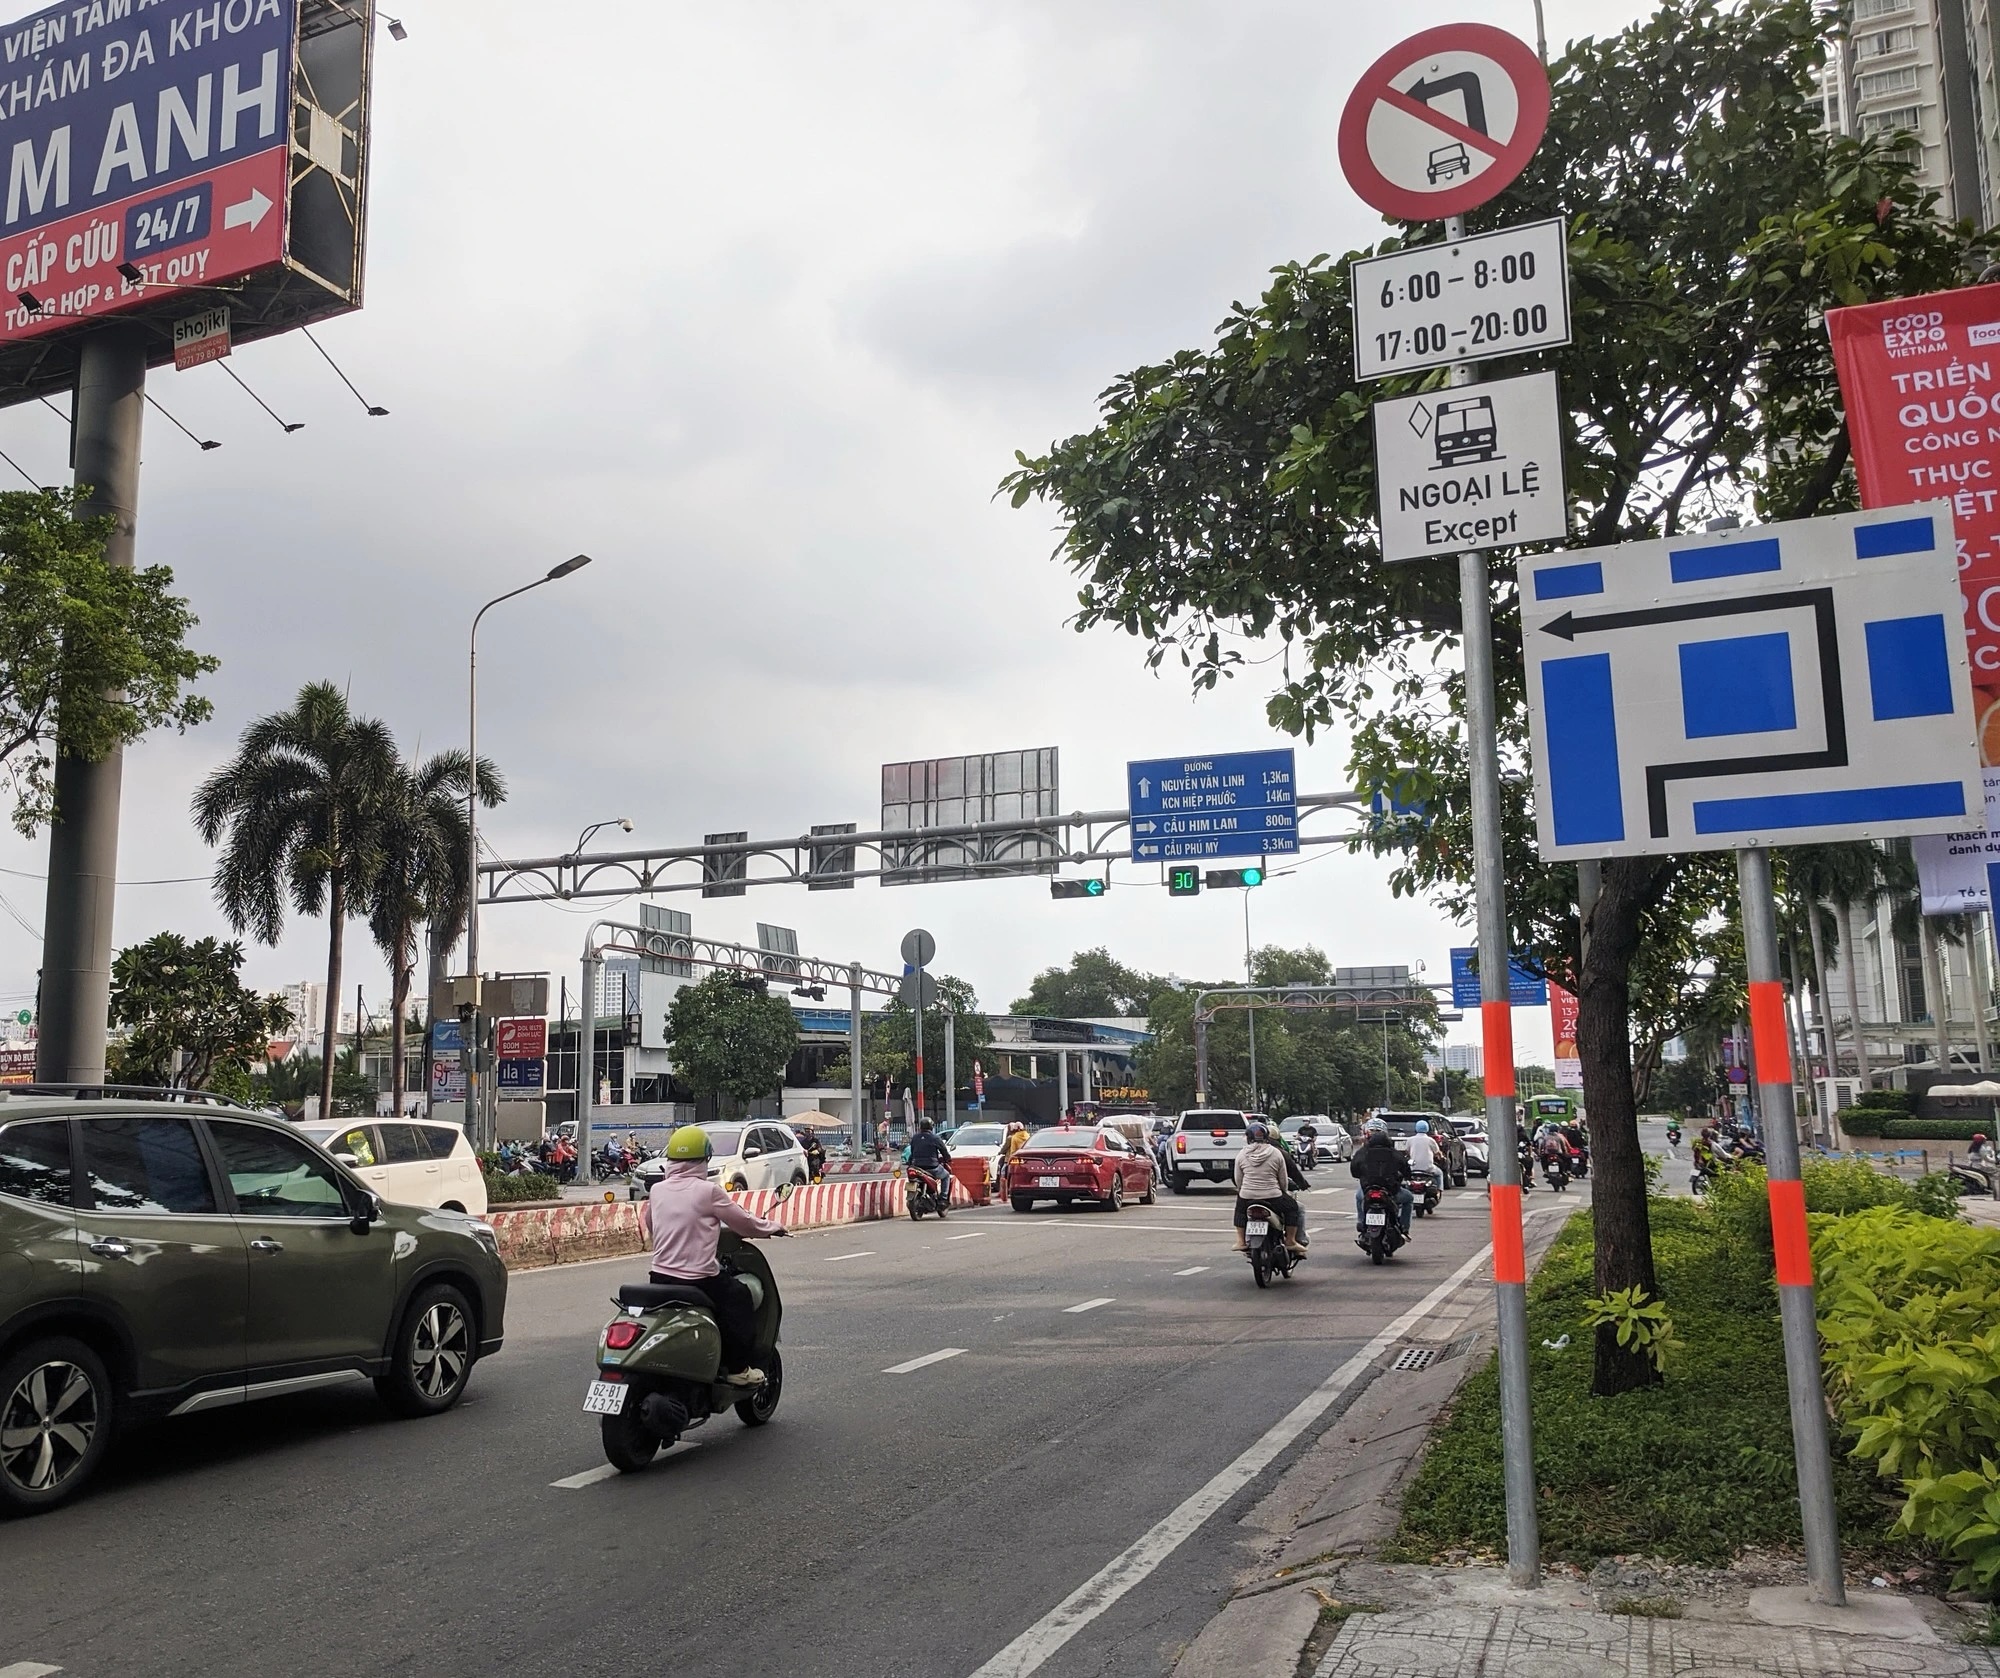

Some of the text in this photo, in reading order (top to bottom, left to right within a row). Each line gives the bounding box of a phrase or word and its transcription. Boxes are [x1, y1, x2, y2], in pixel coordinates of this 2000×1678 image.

[5, 14, 66, 63] VIỆN
[101, 29, 155, 82] ĐA
[169, 0, 281, 57] KHOA
[92, 48, 279, 196] ANH
[6, 195, 201, 293] CẤP CỨU 24/7
[61, 283, 100, 315] HỢP
[104, 286, 115, 301] &
[166, 248, 210, 283] QUỴ
[1380, 270, 1441, 308] 6:00
[1474, 250, 1535, 289] 8:00
[176, 309, 225, 341] shojiki
[1882, 311, 1943, 334] FOOD
[1884, 326, 1946, 348] EXPO
[195, 352, 205, 362] 79
[217, 345, 227, 355] 79
[1888, 341, 1948, 358] VIETNAM
[1891, 355, 1991, 394] TRIỂN
[1905, 430, 1980, 453] CÔNG
[1908, 459, 1992, 486] THỰC
[1399, 461, 1540, 512] NGOẠI LỆ
[1424, 508, 1518, 545] Except
[1161, 771, 1290, 792] NGUYỄN VĂN LINH 1,3Km
[1162, 789, 1291, 810] KCN HIỆP PHƯỚC 14Km
[1189, 819, 1210, 831] HIM
[1213, 817, 1237, 830] LAM
[1265, 814, 1292, 827] 800m
[1184, 840, 1203, 855] PHÚ
[1205, 837, 1219, 854] MỸ
[1262, 838, 1294, 851] 3,3Km
[1949, 843, 1981, 855] danh
[1175, 872, 1194, 889] 30
[1130, 1089, 1149, 1099] BAR
[584, 1396, 622, 1413] 743.75
